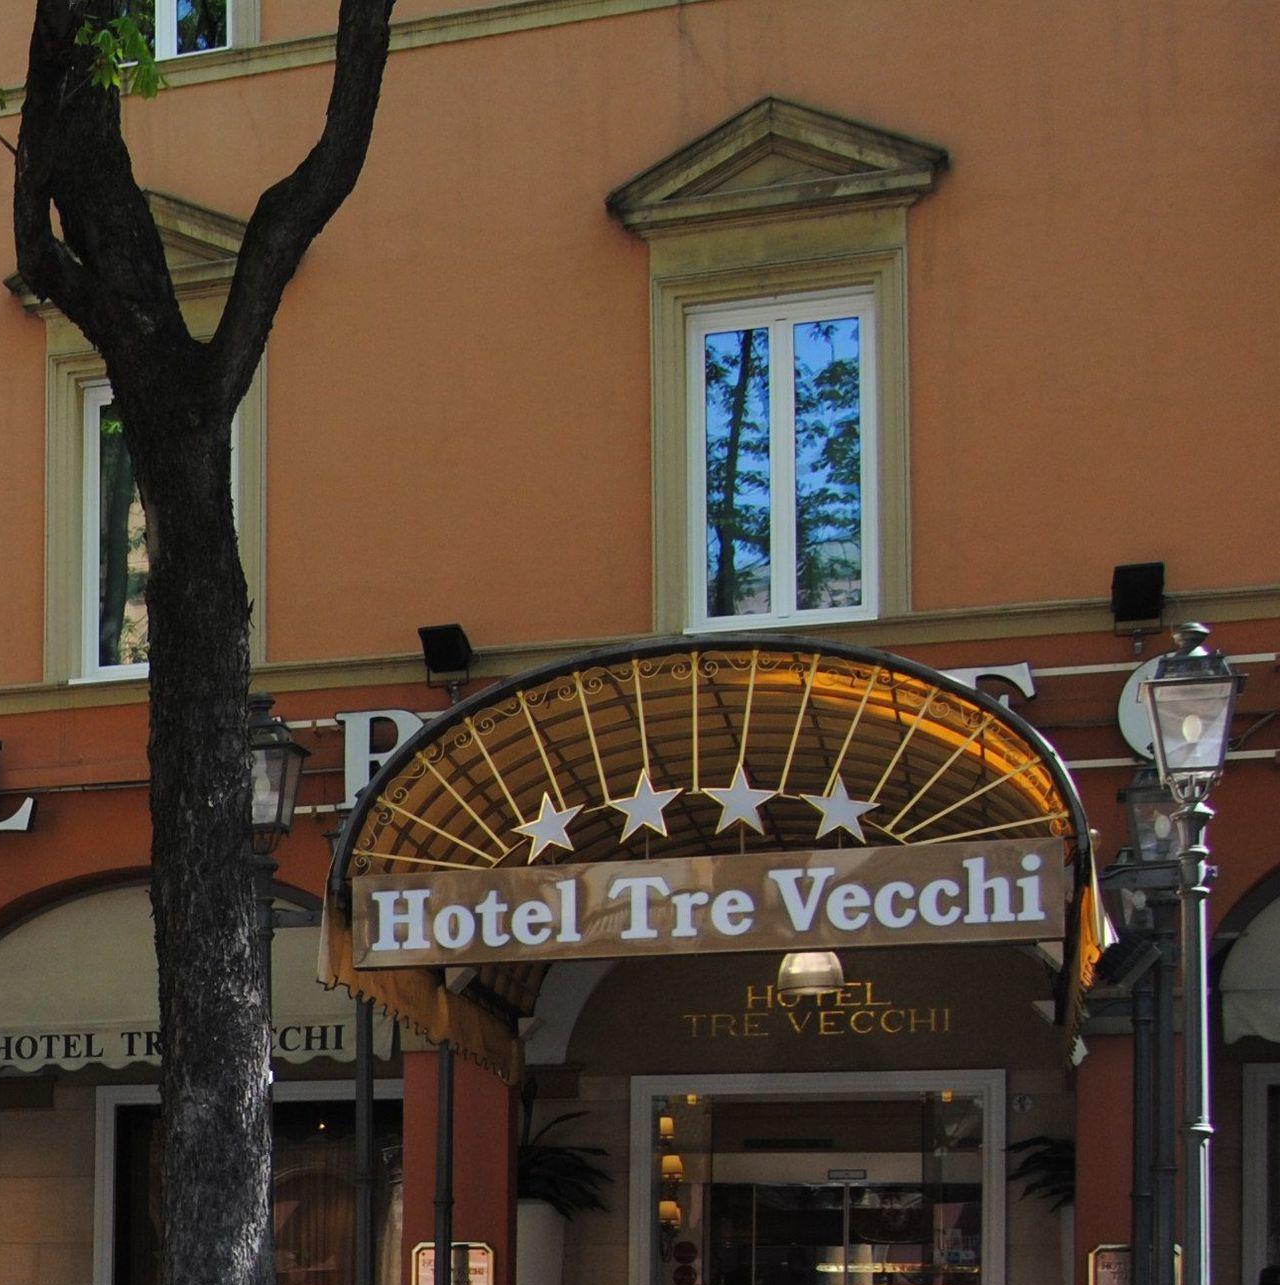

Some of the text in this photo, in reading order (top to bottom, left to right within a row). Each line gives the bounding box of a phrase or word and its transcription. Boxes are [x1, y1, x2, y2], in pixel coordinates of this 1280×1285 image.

[371, 854, 1046, 951] Hotel Tre Vecchi
[685, 1008, 952, 1038] TRE VECCHI
[120, 1031, 162, 1057] TR
